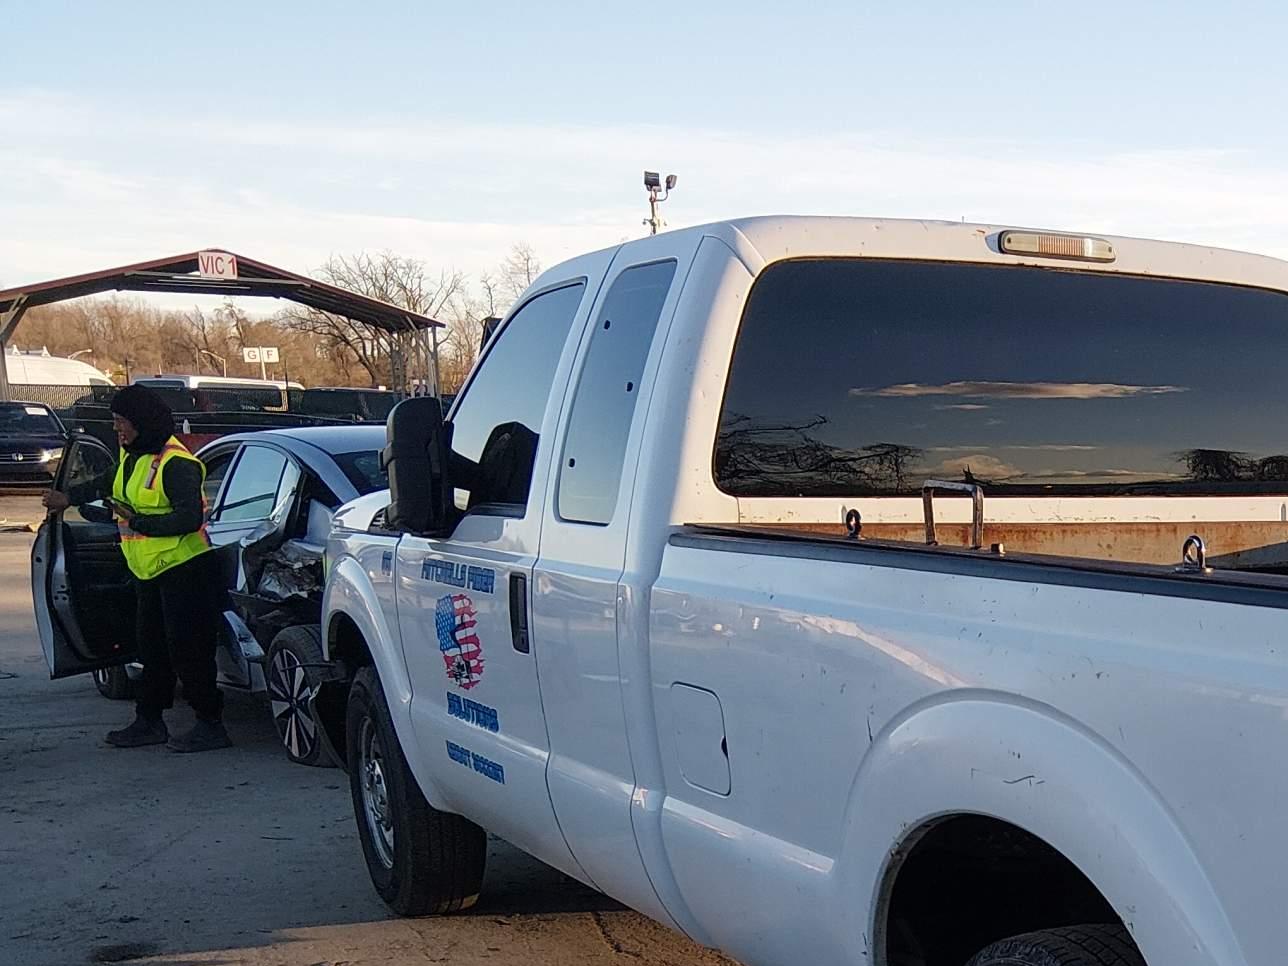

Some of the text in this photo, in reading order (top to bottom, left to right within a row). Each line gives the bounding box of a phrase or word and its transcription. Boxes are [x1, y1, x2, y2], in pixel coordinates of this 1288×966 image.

[200, 255, 236, 275] VIC 1
[247, 350, 257, 360] G
[266, 350, 273, 360] F
